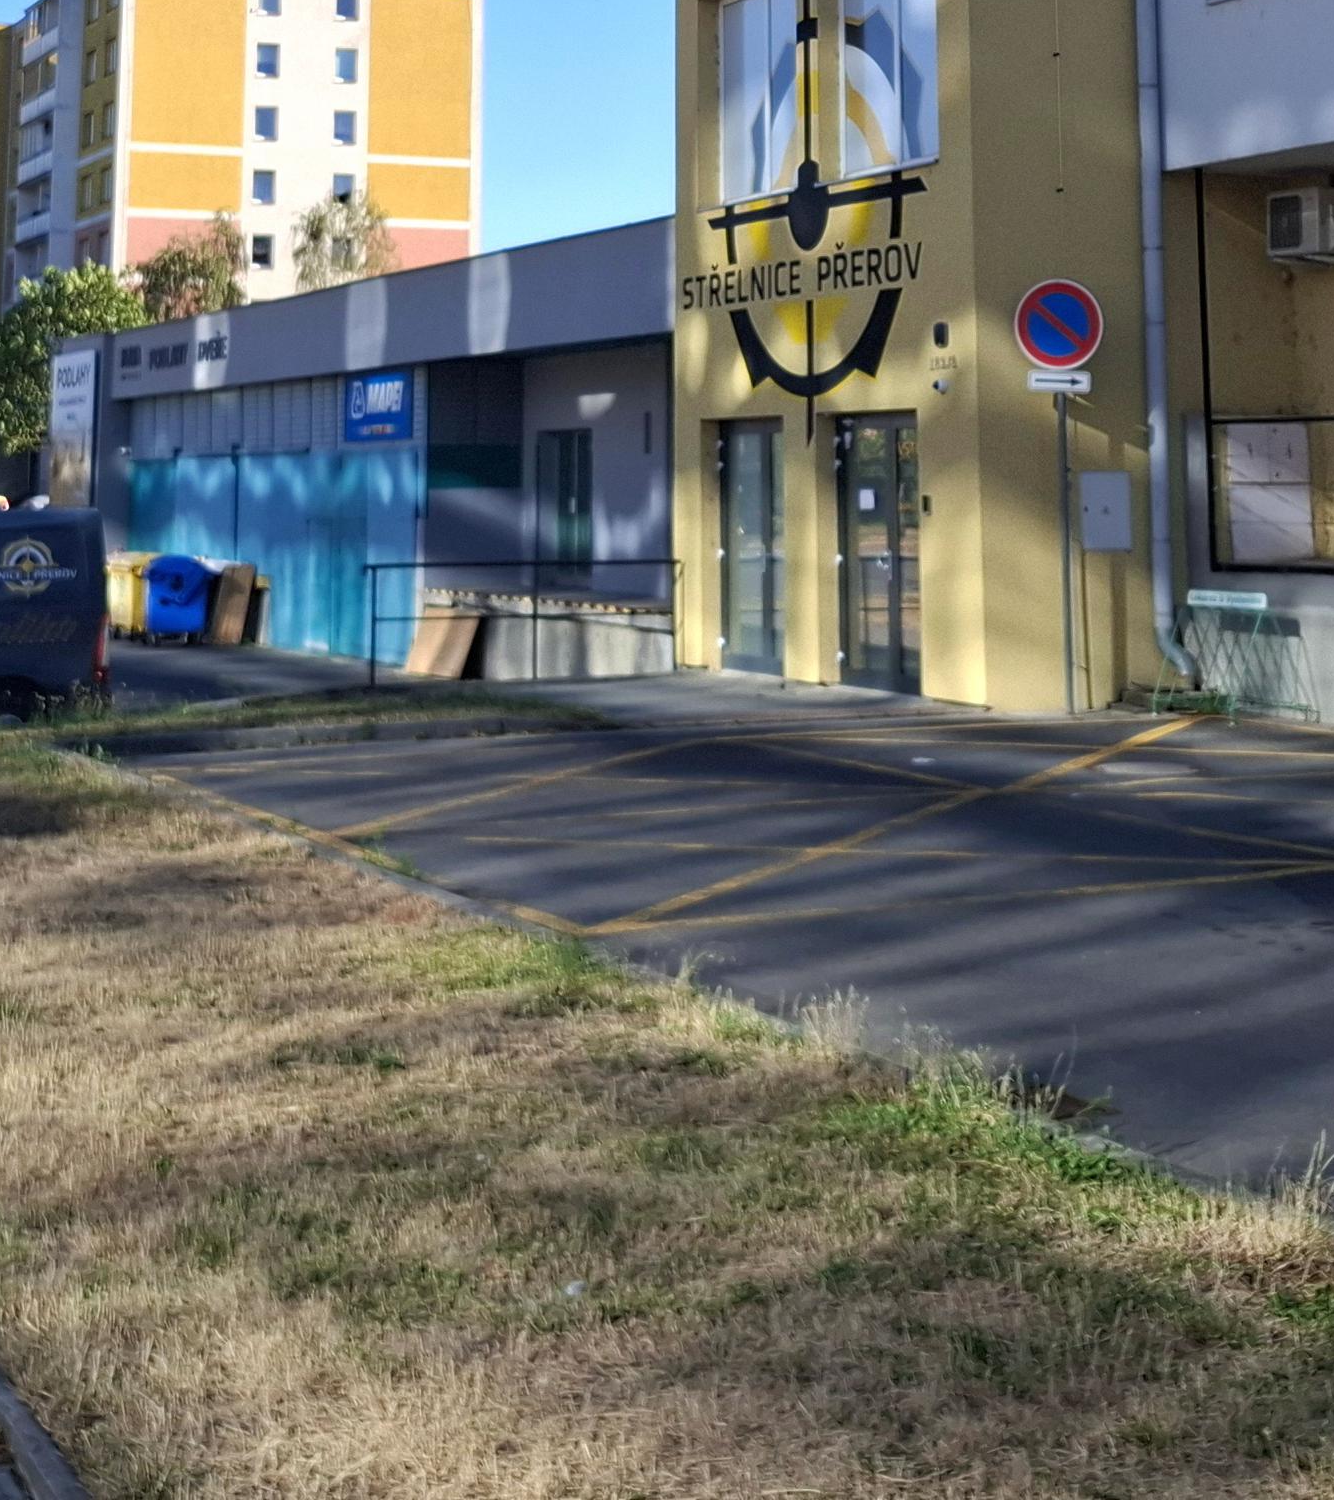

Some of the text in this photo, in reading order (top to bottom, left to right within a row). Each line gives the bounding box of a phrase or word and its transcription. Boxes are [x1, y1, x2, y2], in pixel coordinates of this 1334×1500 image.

[682, 242, 922, 310] STŘELNICE PŘEROV
[57, 363, 92, 389] PODLAHY
[366, 380, 404, 414] MAPEI
